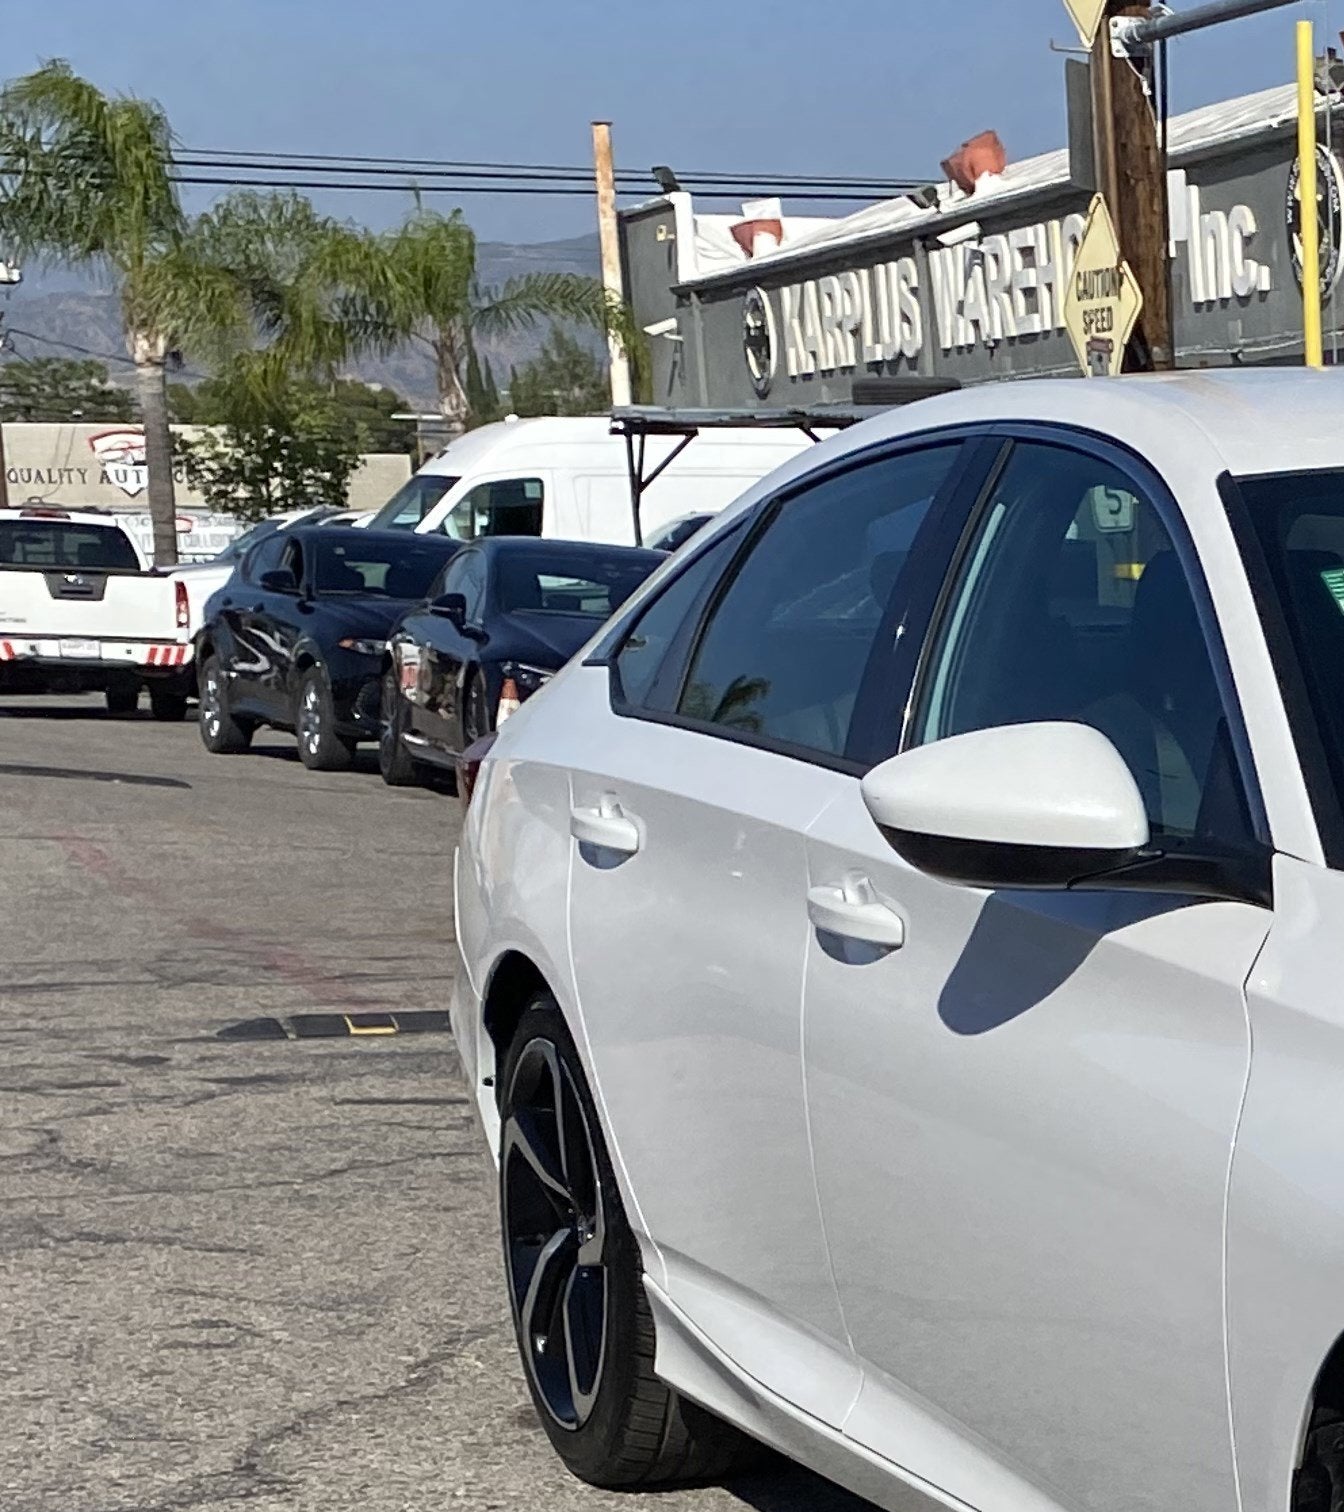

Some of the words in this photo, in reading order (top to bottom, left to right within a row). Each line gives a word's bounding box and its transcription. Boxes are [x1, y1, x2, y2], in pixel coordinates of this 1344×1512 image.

[780, 257, 923, 377] KARPLUS
[1187, 185, 1271, 303] Inc.
[1082, 305, 1114, 335] SPEED
[7, 467, 88, 485] QUALITY
[100, 467, 143, 485] AUT
